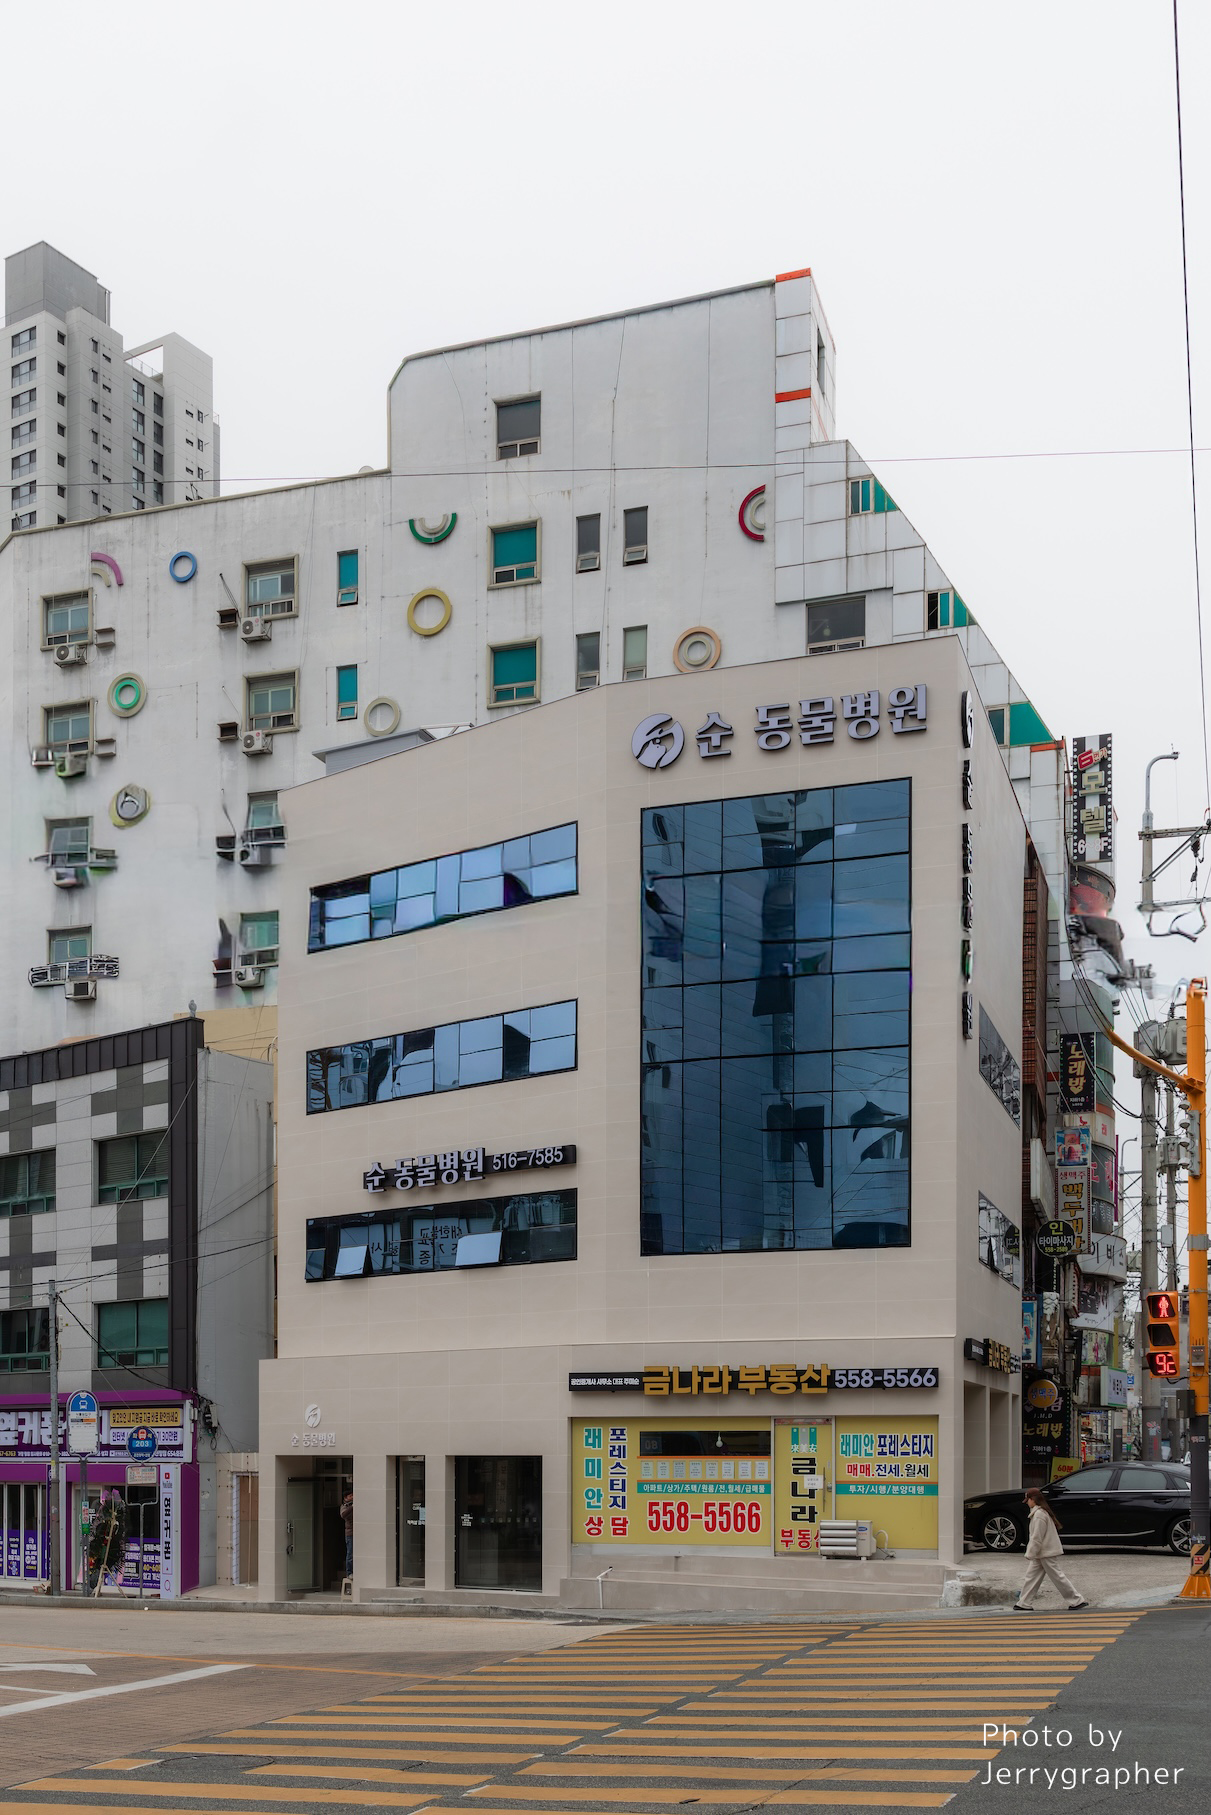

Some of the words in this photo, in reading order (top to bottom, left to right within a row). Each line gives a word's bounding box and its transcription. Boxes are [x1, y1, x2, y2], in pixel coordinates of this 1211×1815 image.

[695, 711, 734, 759] 순
[754, 683, 928, 752] 동물병원
[1079, 770, 1108, 834] 모텔
[1067, 1044, 1087, 1095] 노래방
[366, 1161, 386, 1194] 순
[393, 1147, 486, 1191] 동물병원
[492, 1146, 563, 1171] 516-7585
[1060, 1171, 1086, 1180] 생맥주
[1049, 1221, 1064, 1235] 인
[1039, 1235, 1074, 1247] 타이마사지
[612, 1378, 623, 1386] 대표
[643, 1364, 732, 1395] 금나라
[737, 1363, 831, 1395] 부동산
[834, 1368, 937, 1389] 558-5566
[291, 1433, 300, 1447] 순
[302, 1432, 337, 1448] 동물병원
[1023, 1422, 1064, 1439] 노래방
[135, 1440, 150, 1448] 203
[840, 1433, 875, 1457] 래미안
[877, 1433, 934, 1458] 포레스티지
[583, 1428, 603, 1511] 래미안
[608, 1427, 628, 1511] 포레스티지
[847, 1463, 929, 1478] 매매.전세.월세
[790, 1457, 819, 1524] 금나라
[849, 1485, 925, 1494] 투자/시행/분양대행
[584, 1515, 629, 1538] 상담
[648, 1501, 761, 1534] 558-5566
